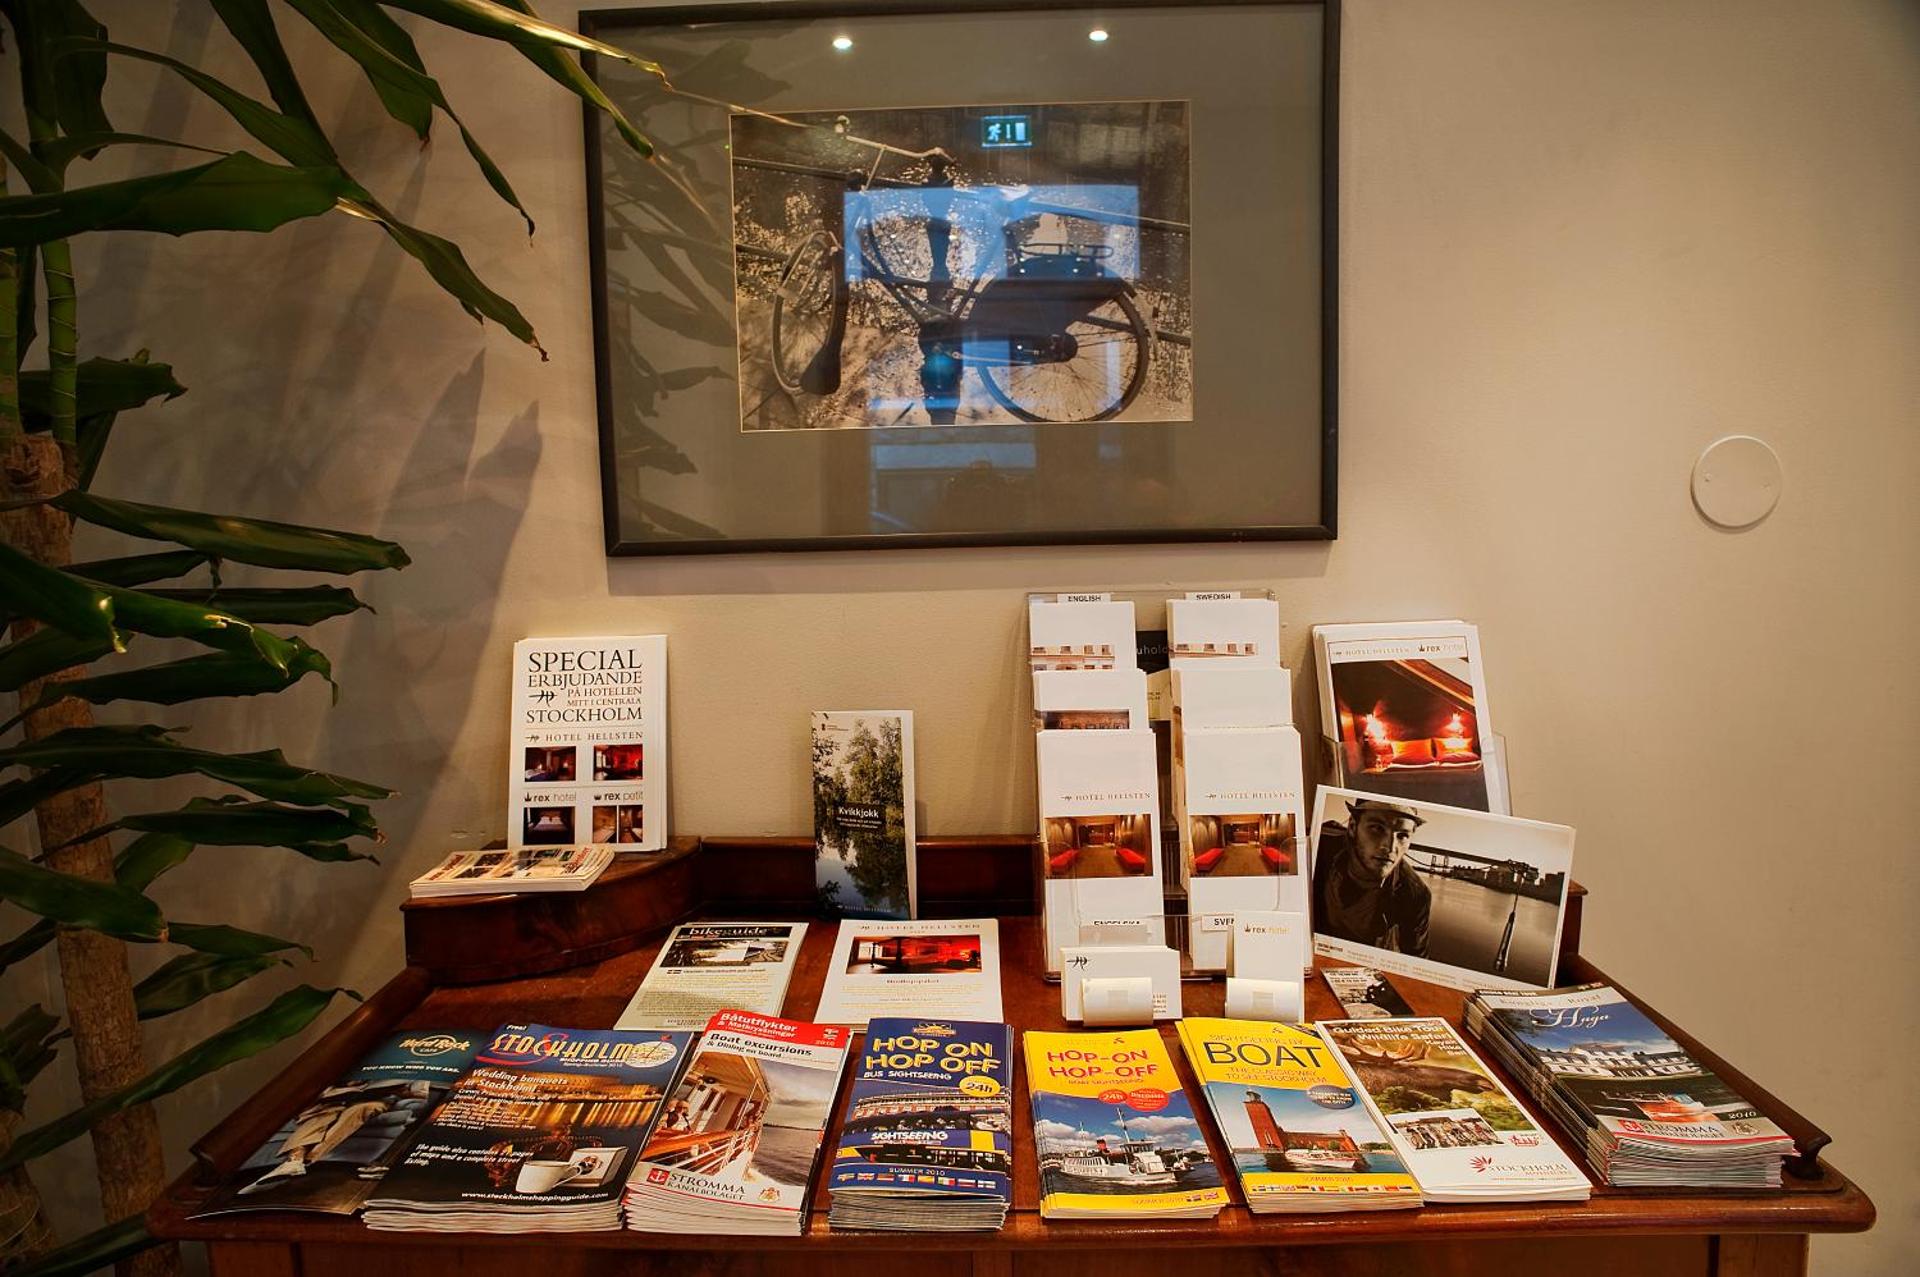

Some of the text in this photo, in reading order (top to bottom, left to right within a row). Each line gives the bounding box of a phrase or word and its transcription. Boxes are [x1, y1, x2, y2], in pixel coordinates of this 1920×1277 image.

[529, 649, 642, 672] SPECIAL
[527, 671, 642, 690] ERBJUDANDE
[568, 686, 642, 697] PÅ HOTELLEN
[596, 698, 642, 706] CENTRALA
[526, 707, 642, 723] STOCKHOLM
[545, 731, 643, 742] HOTEL HELLSTEN
[533, 794, 550, 802] rex
[604, 792, 620, 801] rex
[720, 1013, 798, 1032] Båtutflykter
[1383, 1025, 1413, 1033] Bike
[490, 1033, 635, 1060] STOCKHOLM
[710, 1033, 812, 1056] Boat excursions
[872, 1035, 993, 1058] HOP ON
[1203, 1041, 1322, 1068] BOAT
[865, 1053, 1001, 1075] HOP OFF
[473, 1069, 518, 1082] Wedding
[863, 1070, 952, 1081] BUS SIGHTSEEING
[966, 1081, 993, 1093] 24h
[1728, 1111, 1757, 1119] 2010
[888, 1167, 923, 1175] SUMMER
[669, 1172, 746, 1195] STROMMA
